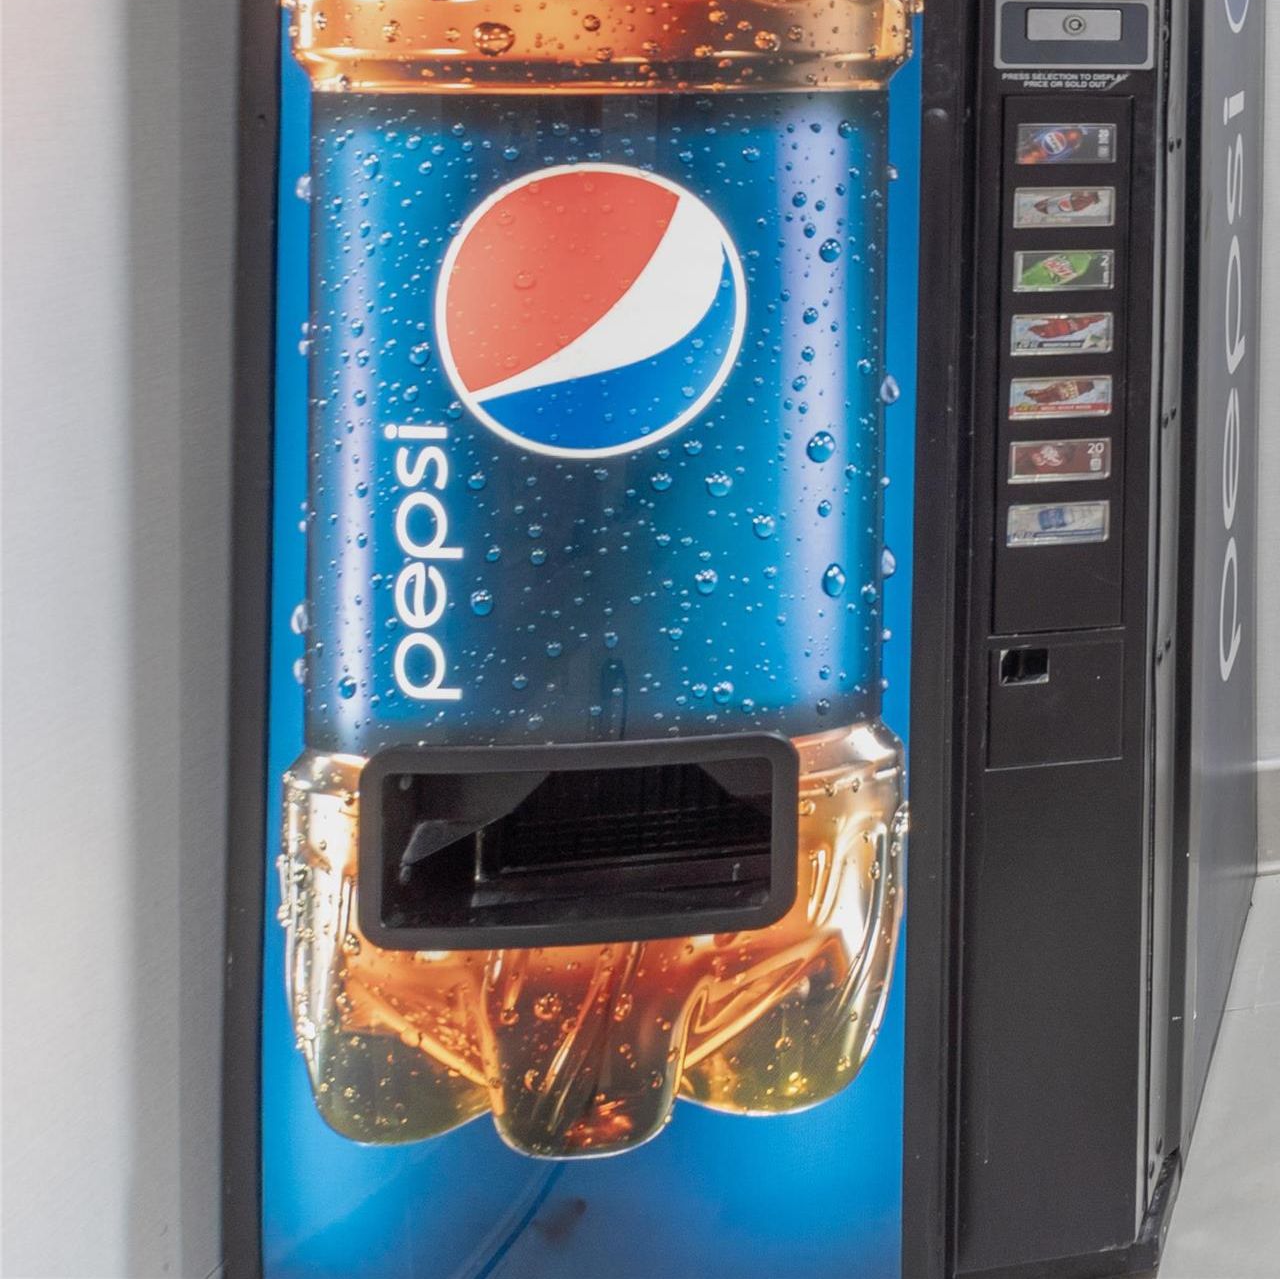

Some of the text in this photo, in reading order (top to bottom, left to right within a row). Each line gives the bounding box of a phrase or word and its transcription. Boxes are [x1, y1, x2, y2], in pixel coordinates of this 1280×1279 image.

[1001, 72, 1130, 81] PRESS SELECTION TO DISPLAY
[1219, 95, 1246, 683] pepsi
[384, 424, 463, 700] pepsi
